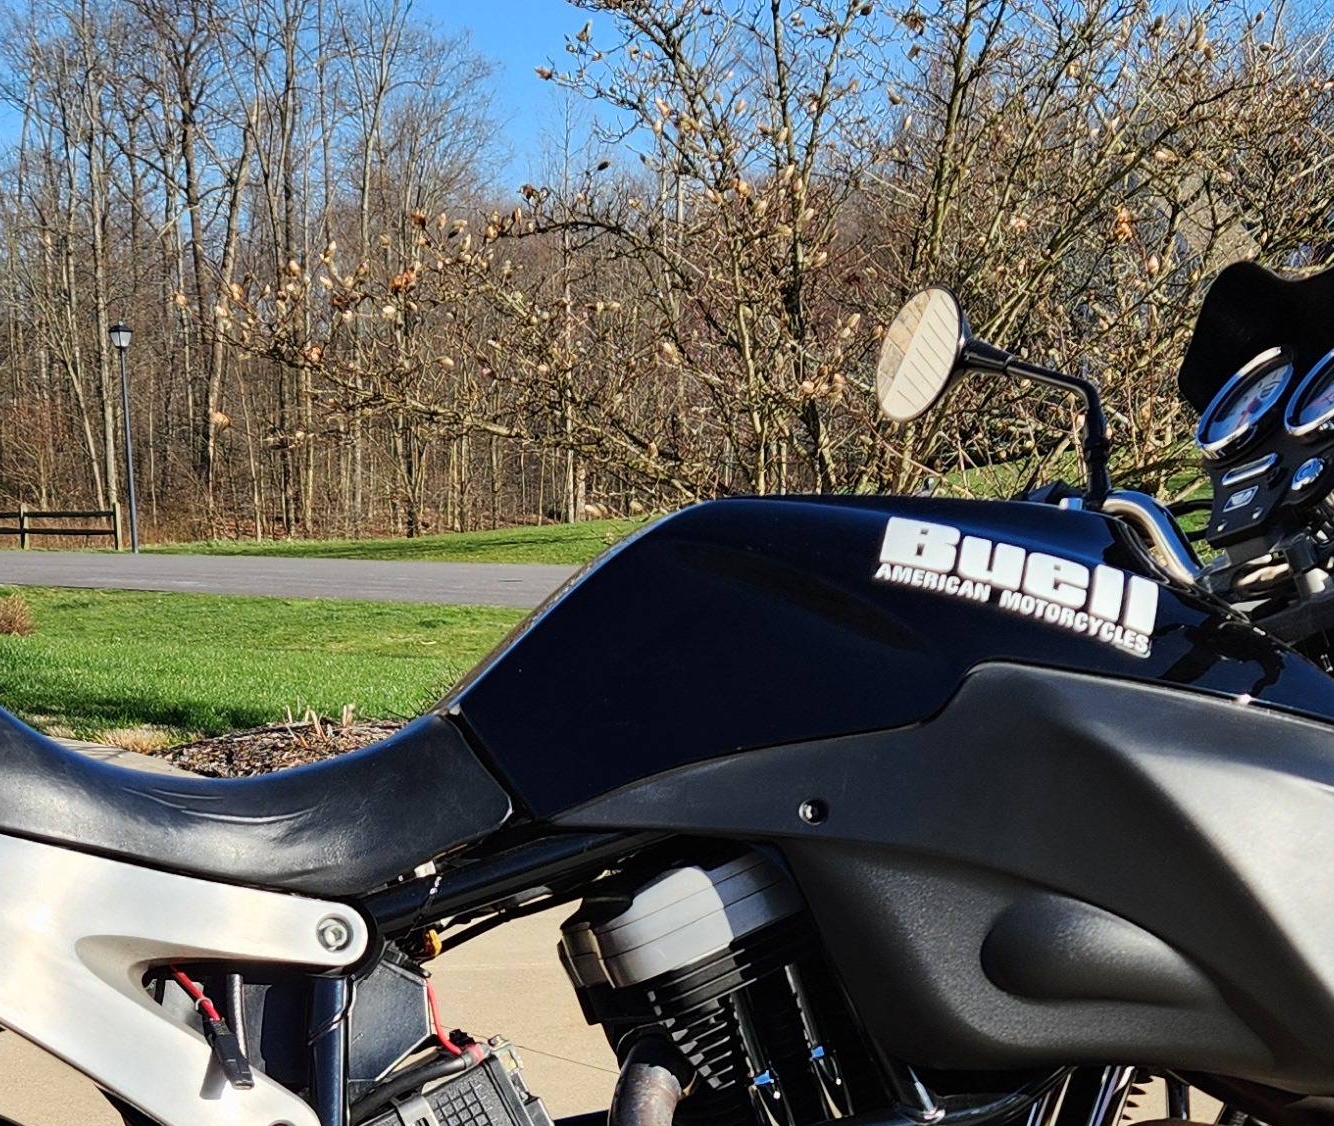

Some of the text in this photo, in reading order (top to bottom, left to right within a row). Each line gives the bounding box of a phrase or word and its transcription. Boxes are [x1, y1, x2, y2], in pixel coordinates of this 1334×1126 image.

[874, 563, 1150, 653] AMERICAN MOTORCYCLES
[878, 516, 1159, 636] Buell
